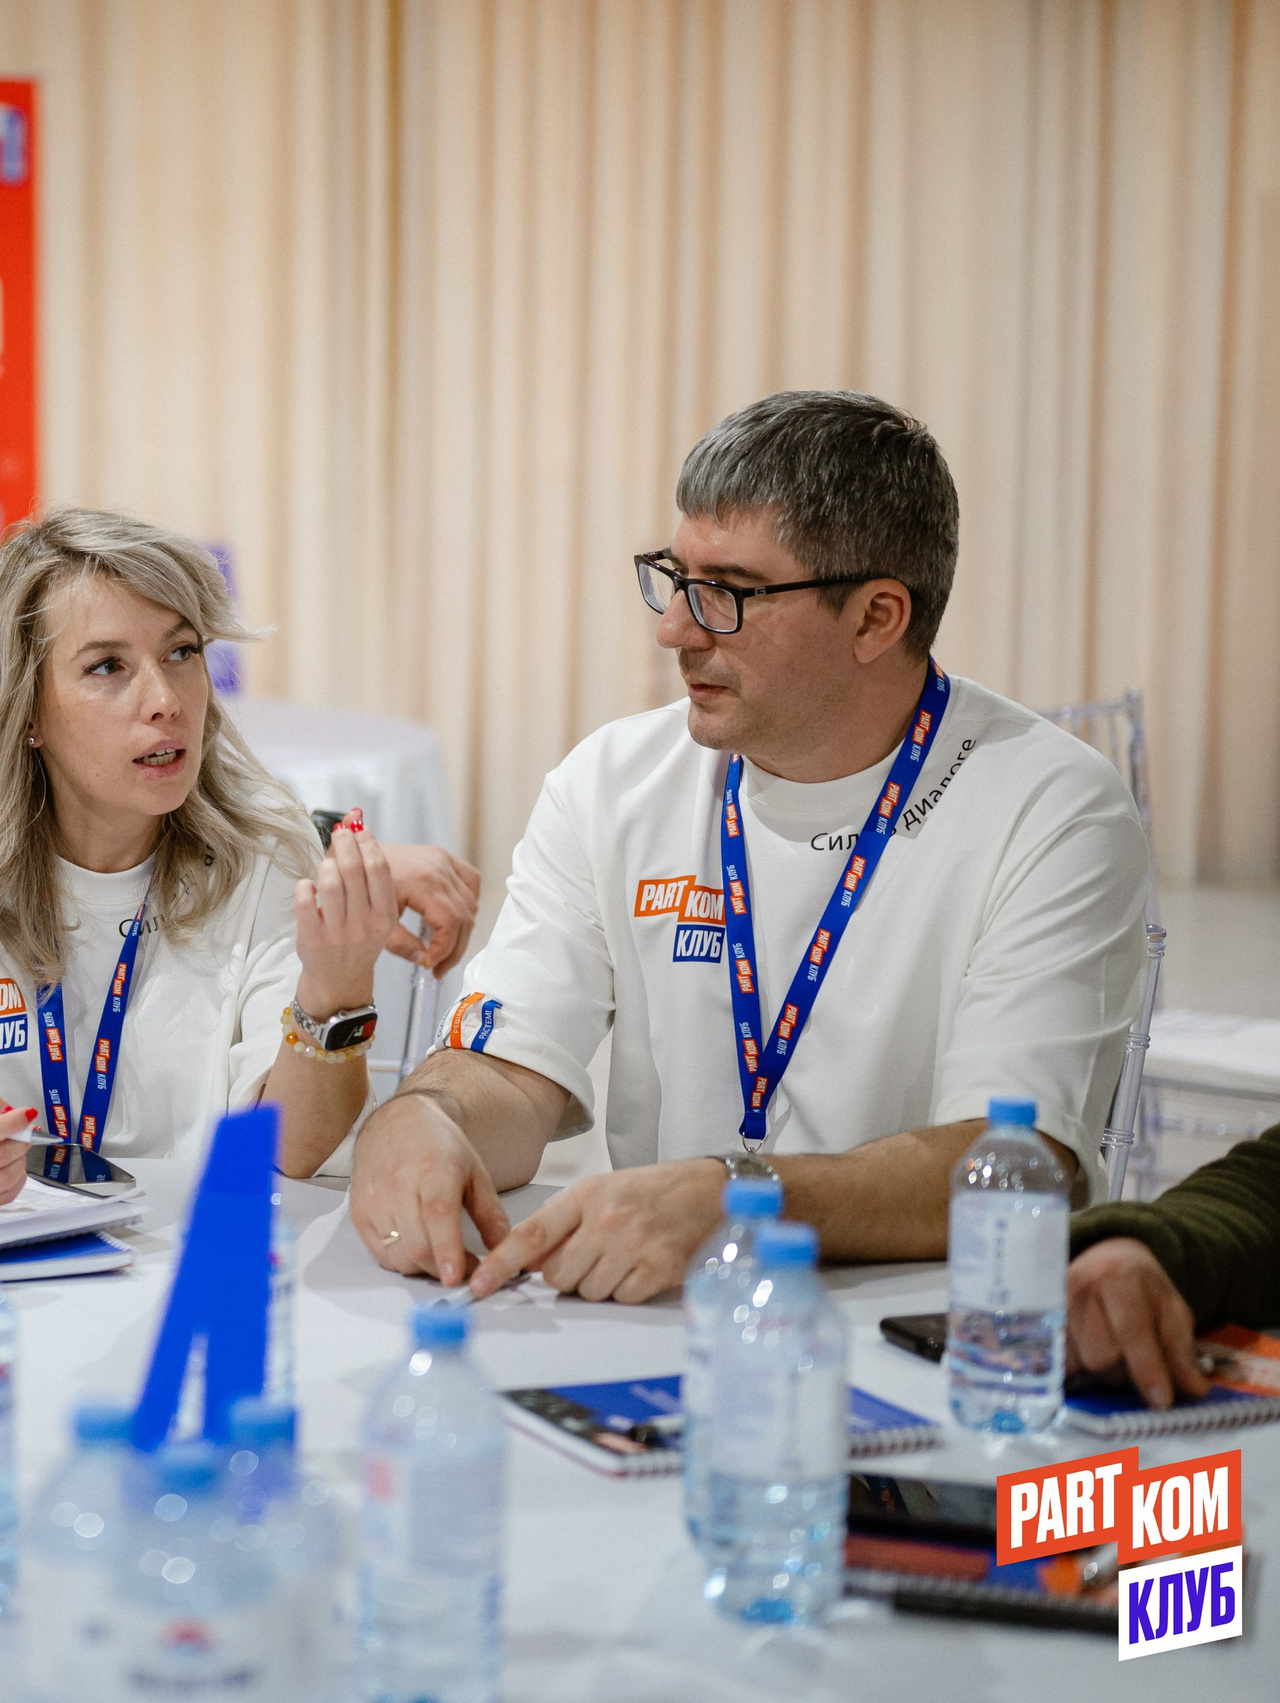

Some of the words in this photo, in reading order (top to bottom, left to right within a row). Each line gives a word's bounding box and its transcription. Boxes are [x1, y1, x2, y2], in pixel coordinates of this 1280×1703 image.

[640, 880, 688, 911] PART
[684, 891, 724, 920] KOM
[676, 930, 722, 958] КЛУБ
